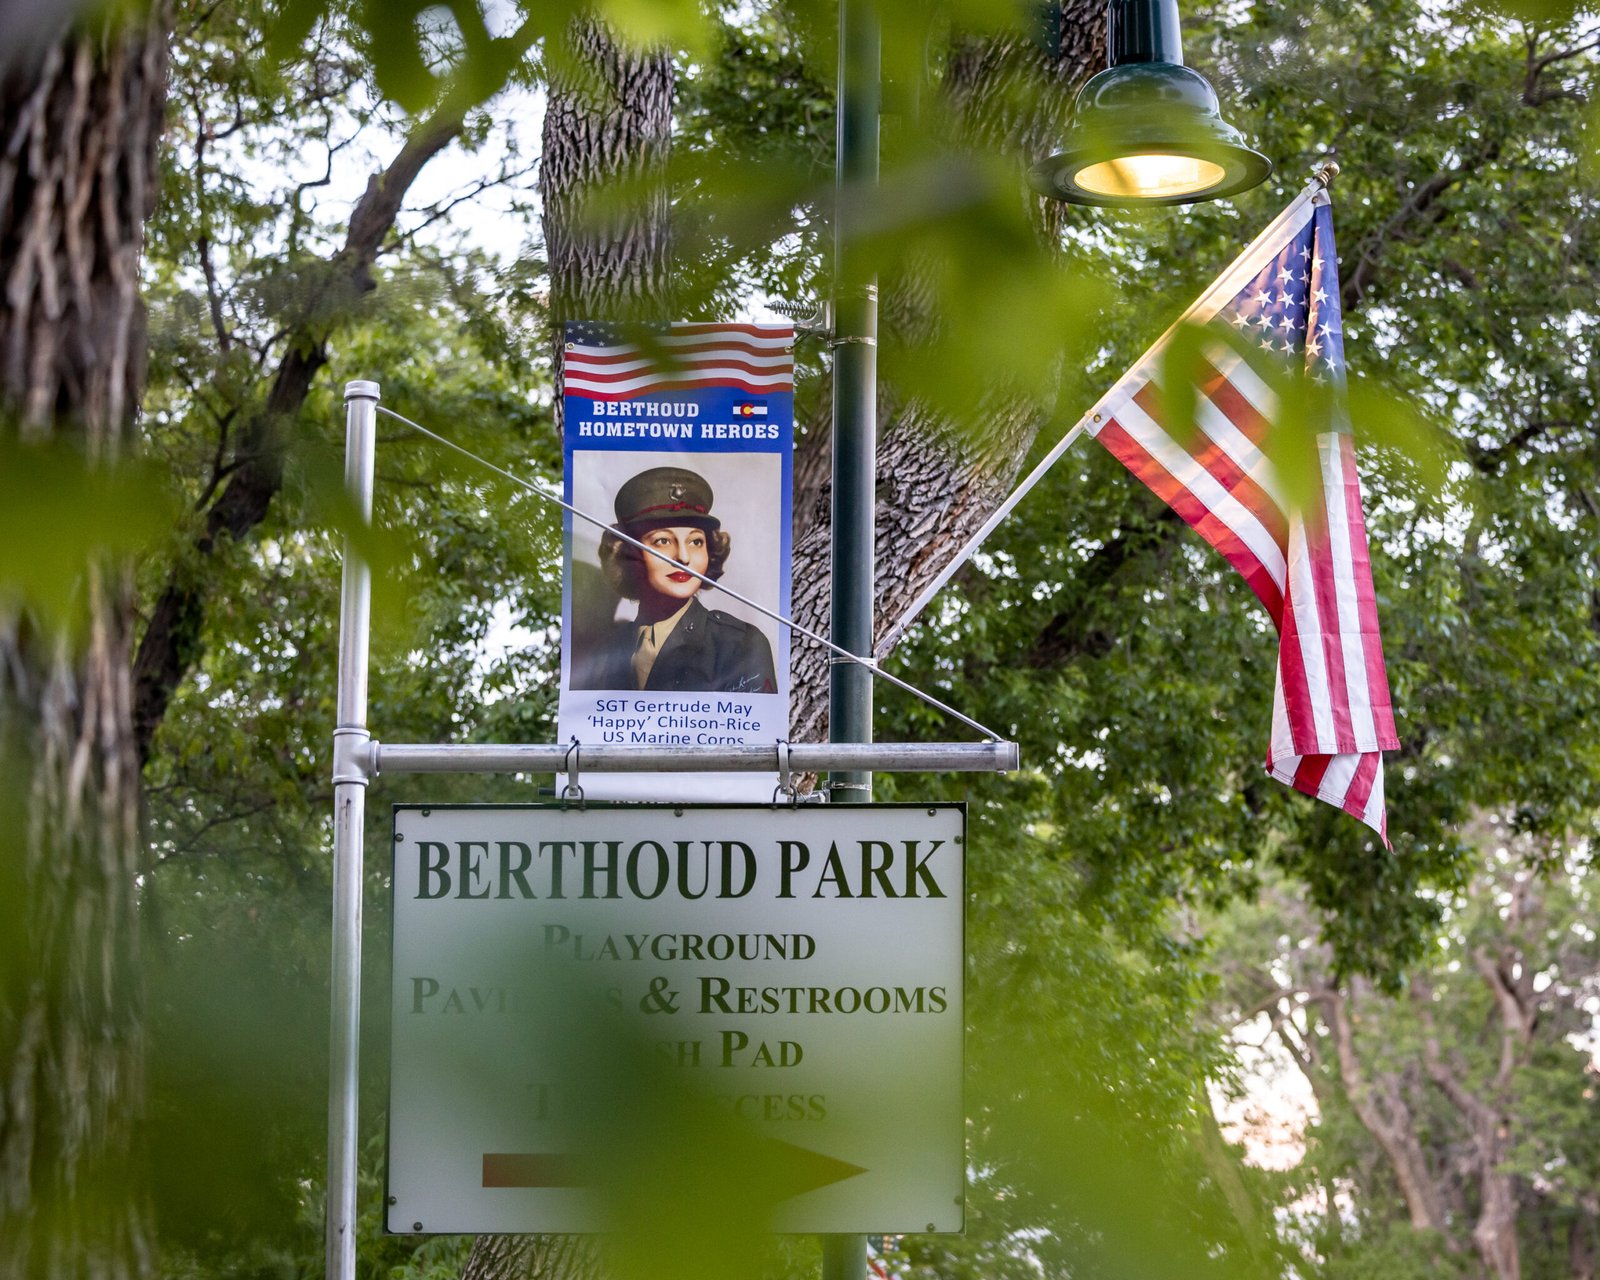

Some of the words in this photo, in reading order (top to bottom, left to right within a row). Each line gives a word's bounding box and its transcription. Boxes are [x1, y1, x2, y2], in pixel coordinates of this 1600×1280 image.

[593, 402, 698, 417] BERTHOUD
[579, 422, 693, 437] HOMETOWN
[701, 424, 779, 439] HEROES
[596, 700, 628, 713] SGT
[634, 700, 711, 713] Gertrude
[717, 702, 753, 717] May
[657, 716, 761, 731] Chilson-Rice
[603, 731, 625, 743] US
[631, 731, 691, 744] Marine
[414, 840, 757, 900] BERTHOUD
[775, 839, 948, 899] PARK
[542, 924, 816, 960] PLAYGROUND
[639, 976, 680, 1014] &
[697, 976, 947, 1014] RESTROOMS
[718, 1030, 803, 1068] PAD
